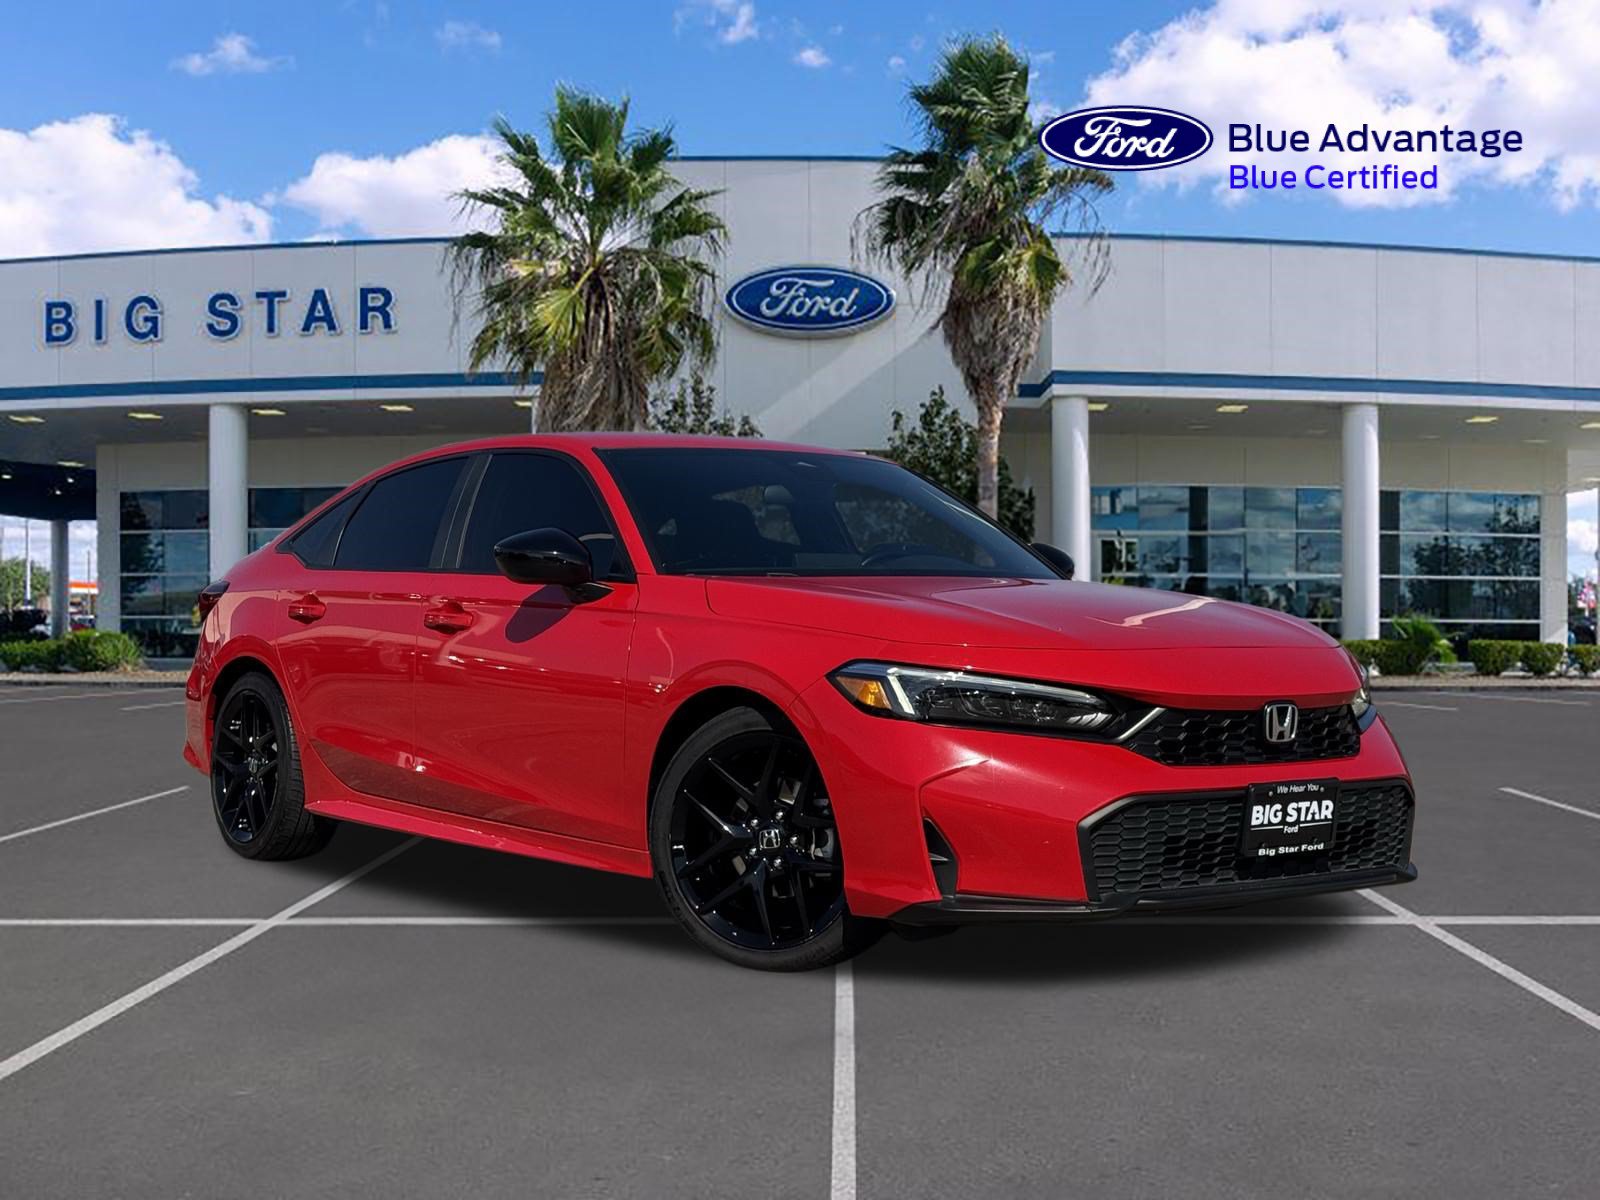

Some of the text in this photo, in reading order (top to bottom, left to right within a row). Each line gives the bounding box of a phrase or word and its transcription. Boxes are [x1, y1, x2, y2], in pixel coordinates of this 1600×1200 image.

[759, 277, 859, 317] Ford
[43, 286, 396, 346] BIG STAR
[1277, 783, 1319, 794] We Hear You
[1250, 800, 1333, 826] BIG STAR
[1283, 825, 1299, 834] Ford
[1258, 842, 1324, 857] Big Star Ford
